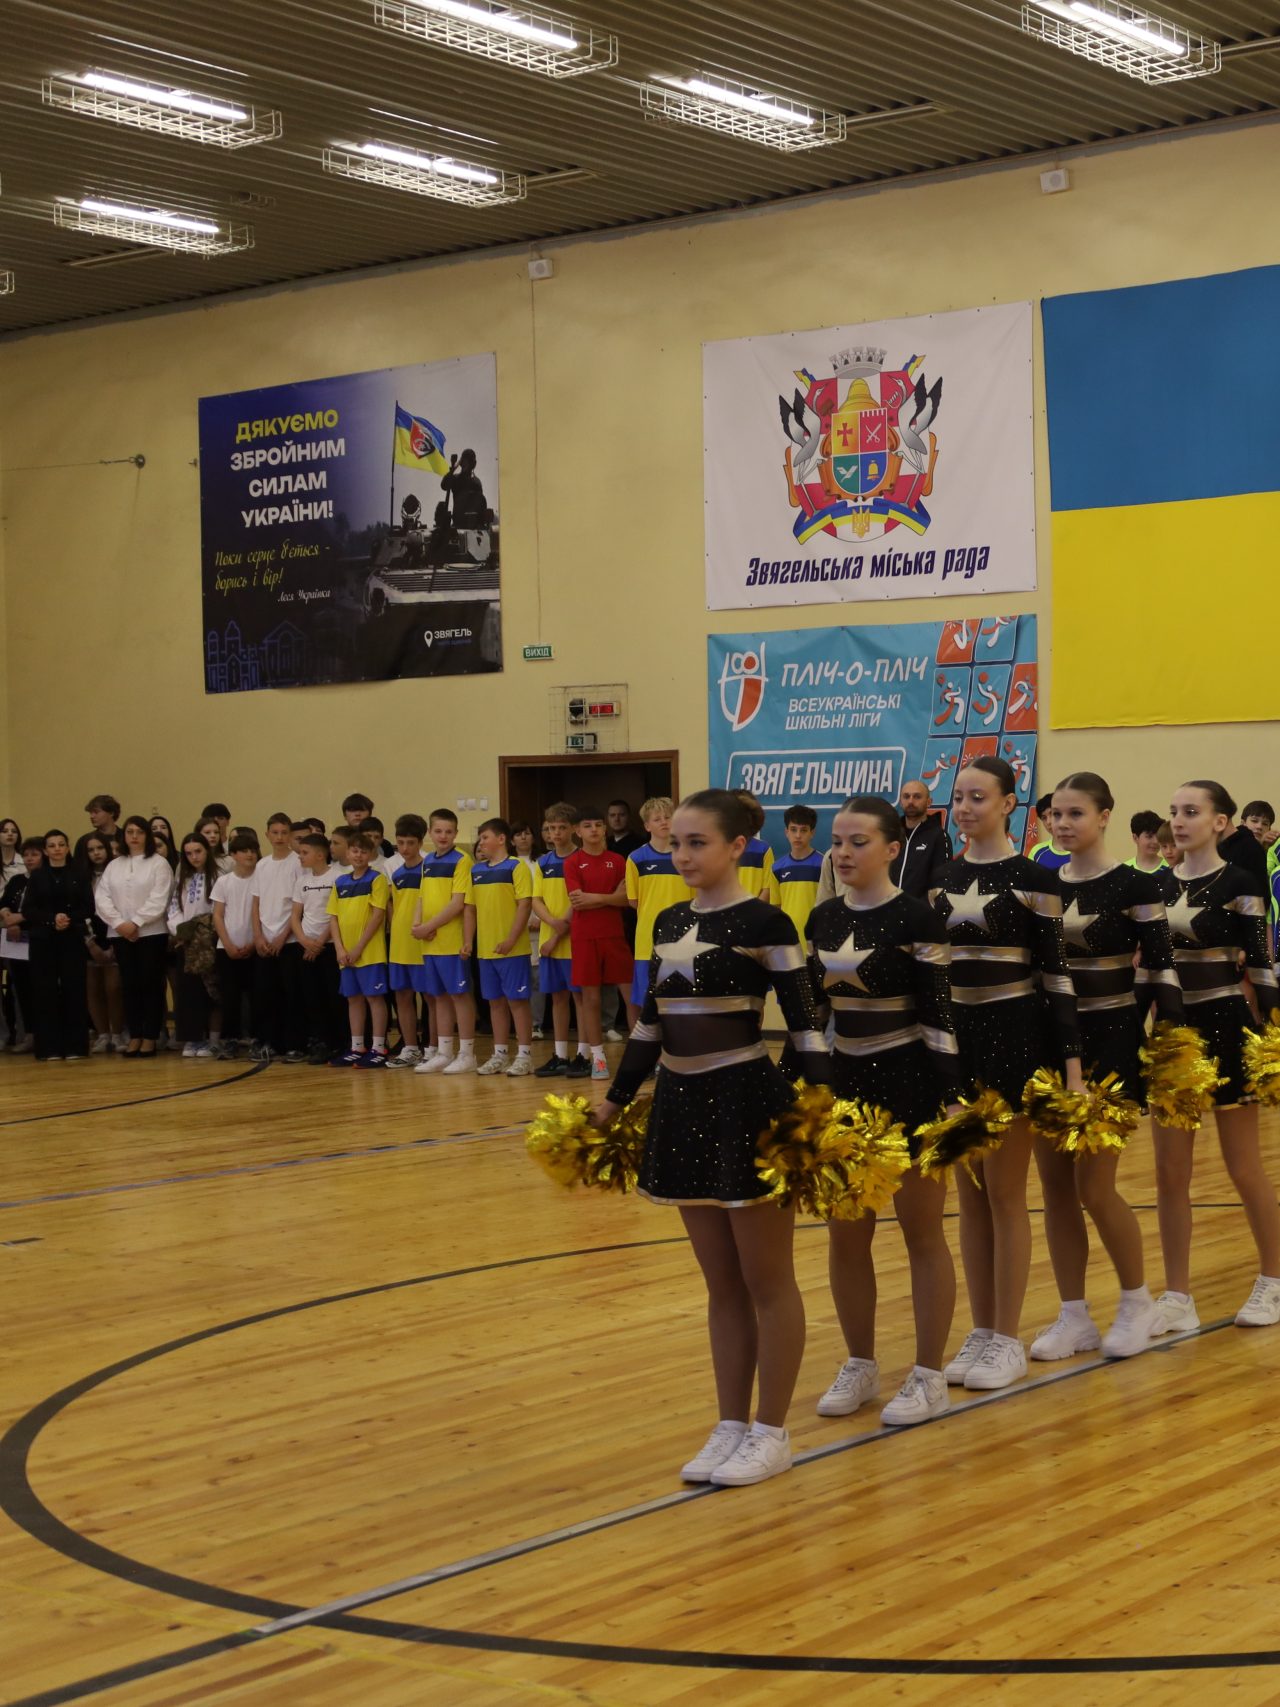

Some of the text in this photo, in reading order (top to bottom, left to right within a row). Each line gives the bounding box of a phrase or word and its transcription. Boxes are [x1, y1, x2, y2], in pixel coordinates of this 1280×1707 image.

[235, 409, 339, 444] ДЯКУЄМО
[230, 437, 346, 471] ЗБРОЙНИМ
[248, 470, 327, 498] СИЛАМ
[240, 499, 333, 528] УКРАЇНИ!
[252, 571, 258, 586] і
[745, 546, 991, 586] Звягельська міська рада
[434, 628, 472, 639] ЗВЯГЕЛЬ
[525, 647, 550, 658] ВИХІД
[781, 656, 929, 687] ПЛІЧ-О-ПЛІЧ
[788, 692, 902, 713] ВСЕУКРАЇНСЬКІ
[785, 712, 882, 731] ШКІЛЬНІ ЛІГИ
[740, 759, 893, 797] ЗВЯГЕЛЬЩИНА
